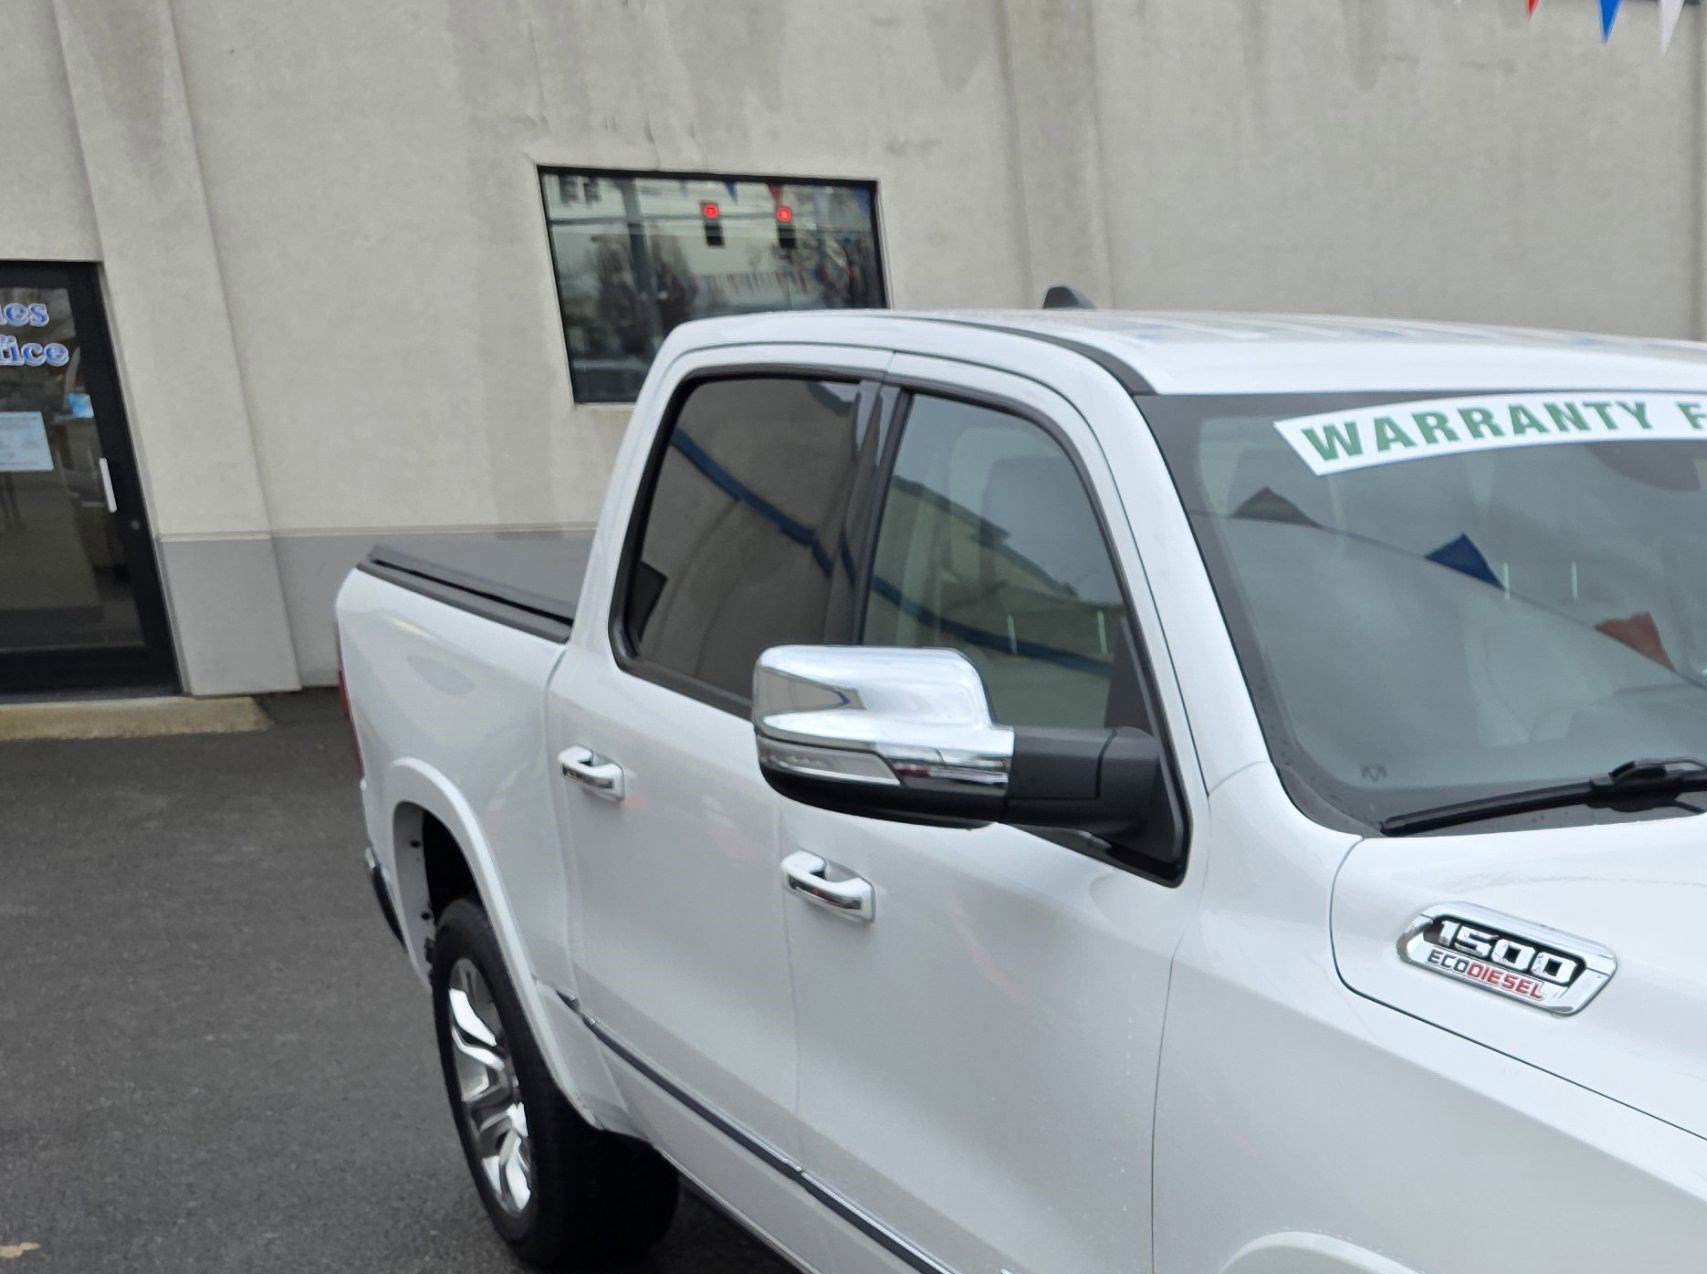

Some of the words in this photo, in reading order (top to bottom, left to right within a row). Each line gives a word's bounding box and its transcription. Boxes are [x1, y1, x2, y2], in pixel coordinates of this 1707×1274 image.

[1301, 400, 1652, 462] WARRANTY
[1427, 948, 1543, 1000] ECODIESEL
[1437, 919, 1577, 985] 1500
